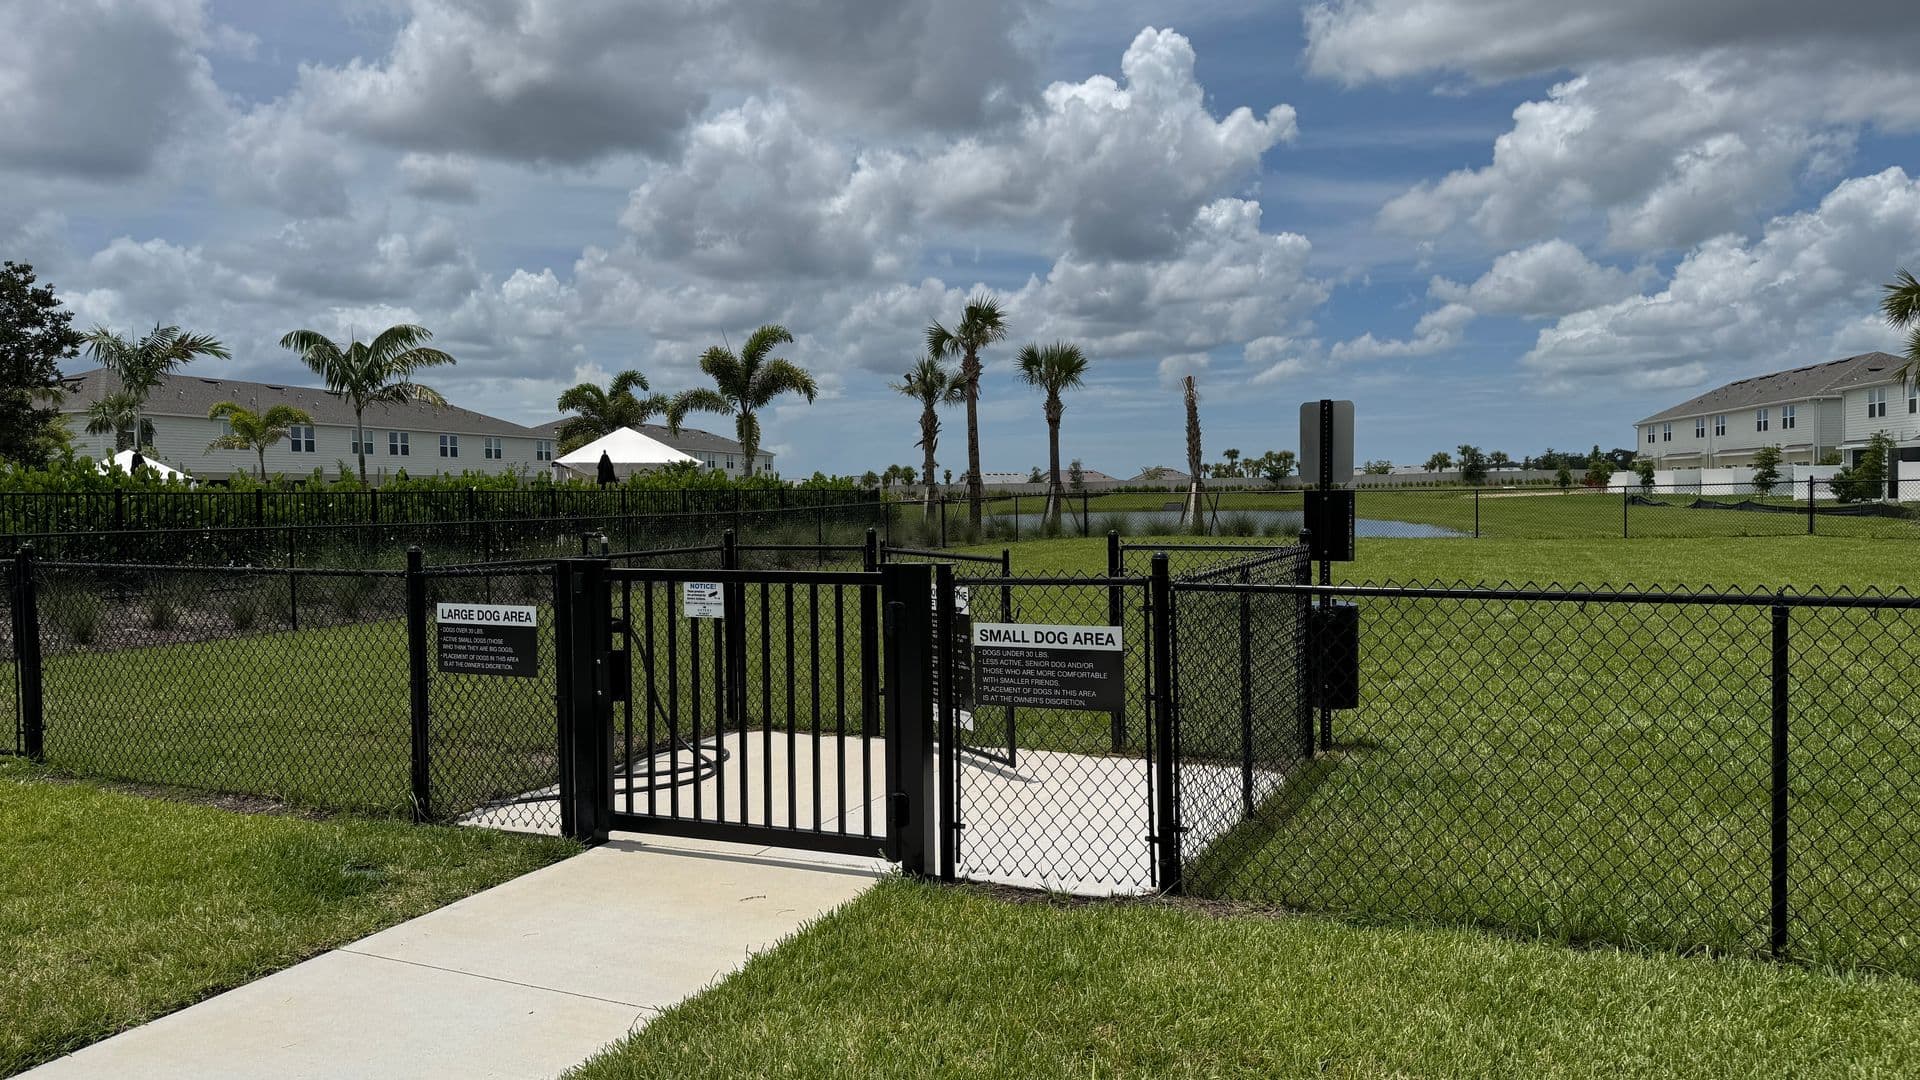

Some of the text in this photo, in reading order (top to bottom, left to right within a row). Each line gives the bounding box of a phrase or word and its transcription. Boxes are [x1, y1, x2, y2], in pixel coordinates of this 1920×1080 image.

[442, 608, 532, 622] LARGE DOG AREA
[980, 629, 1116, 646] SMALL DOG AREA
